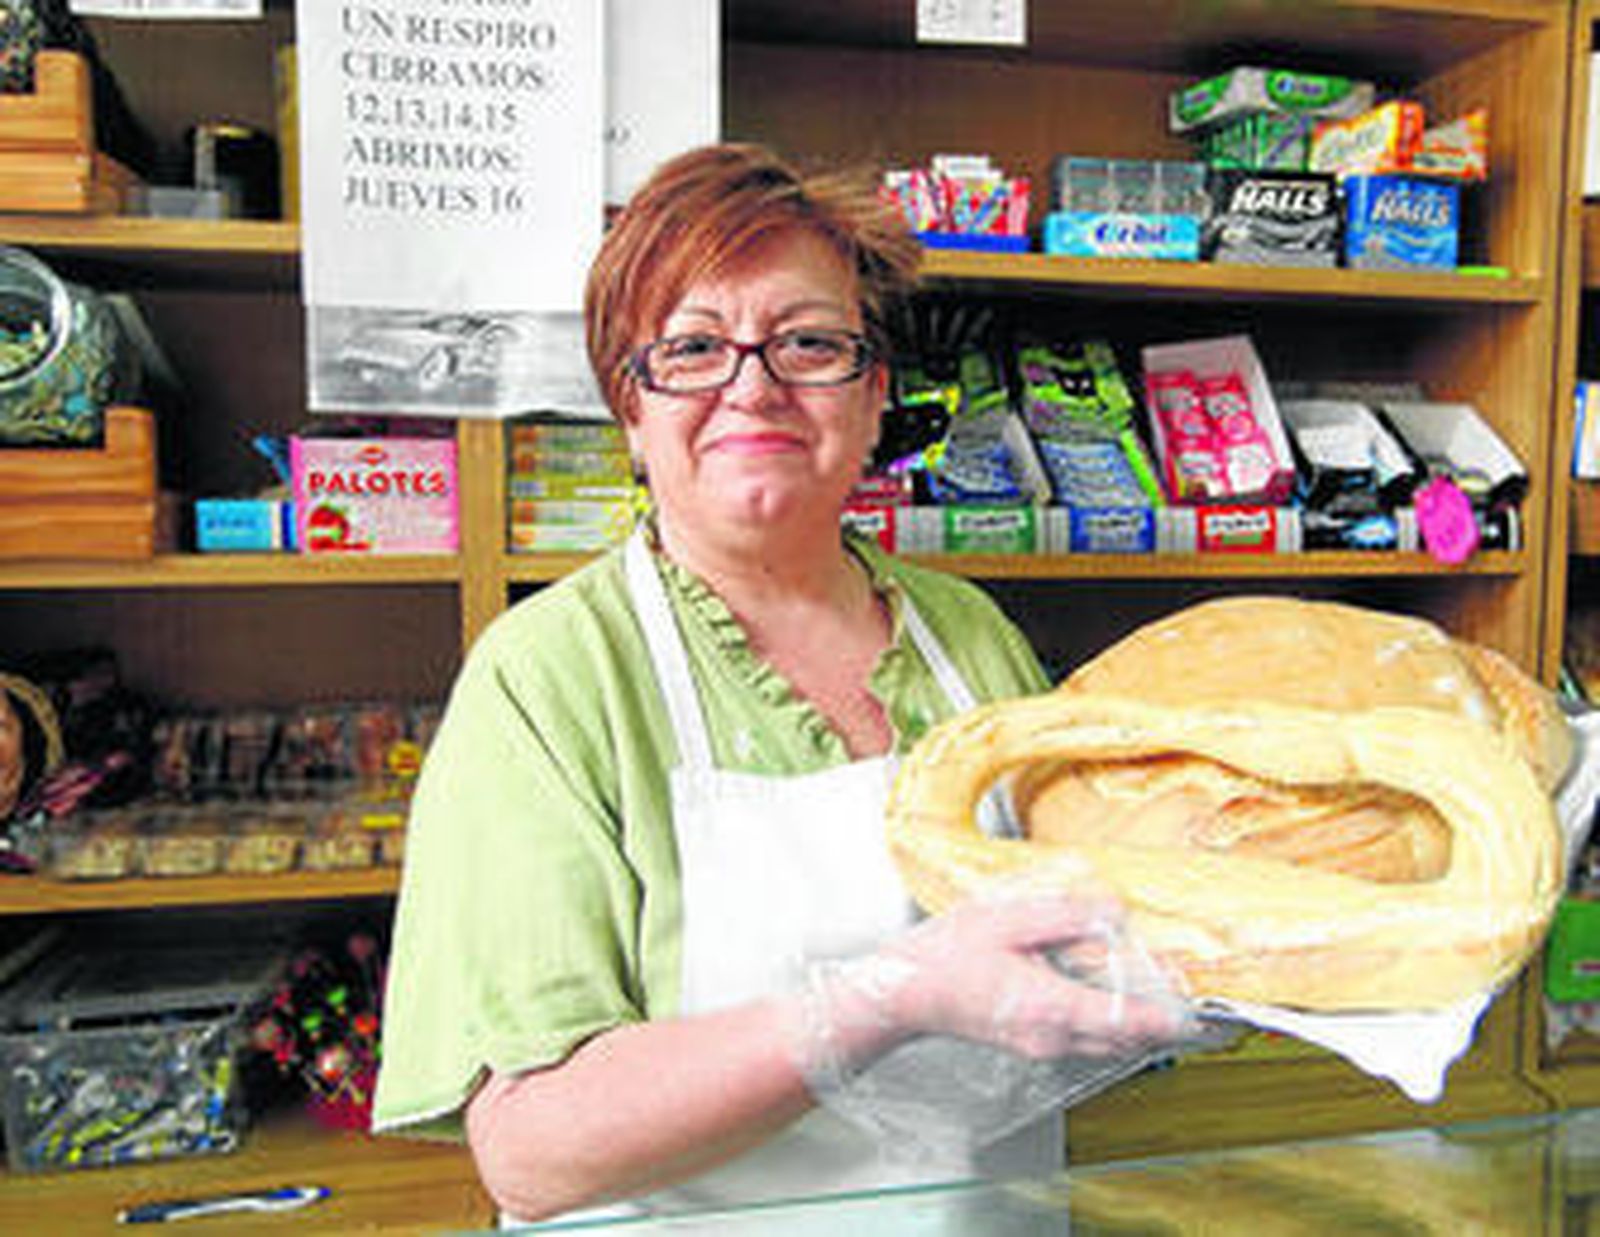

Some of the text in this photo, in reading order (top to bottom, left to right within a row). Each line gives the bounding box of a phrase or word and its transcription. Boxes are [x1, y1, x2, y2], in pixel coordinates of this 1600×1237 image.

[342, 7, 557, 51] UN RESPIRO
[343, 176, 524, 214] JUEVES 16
[1229, 182, 1329, 216] HALLS
[307, 469, 448, 496] PALOTES
